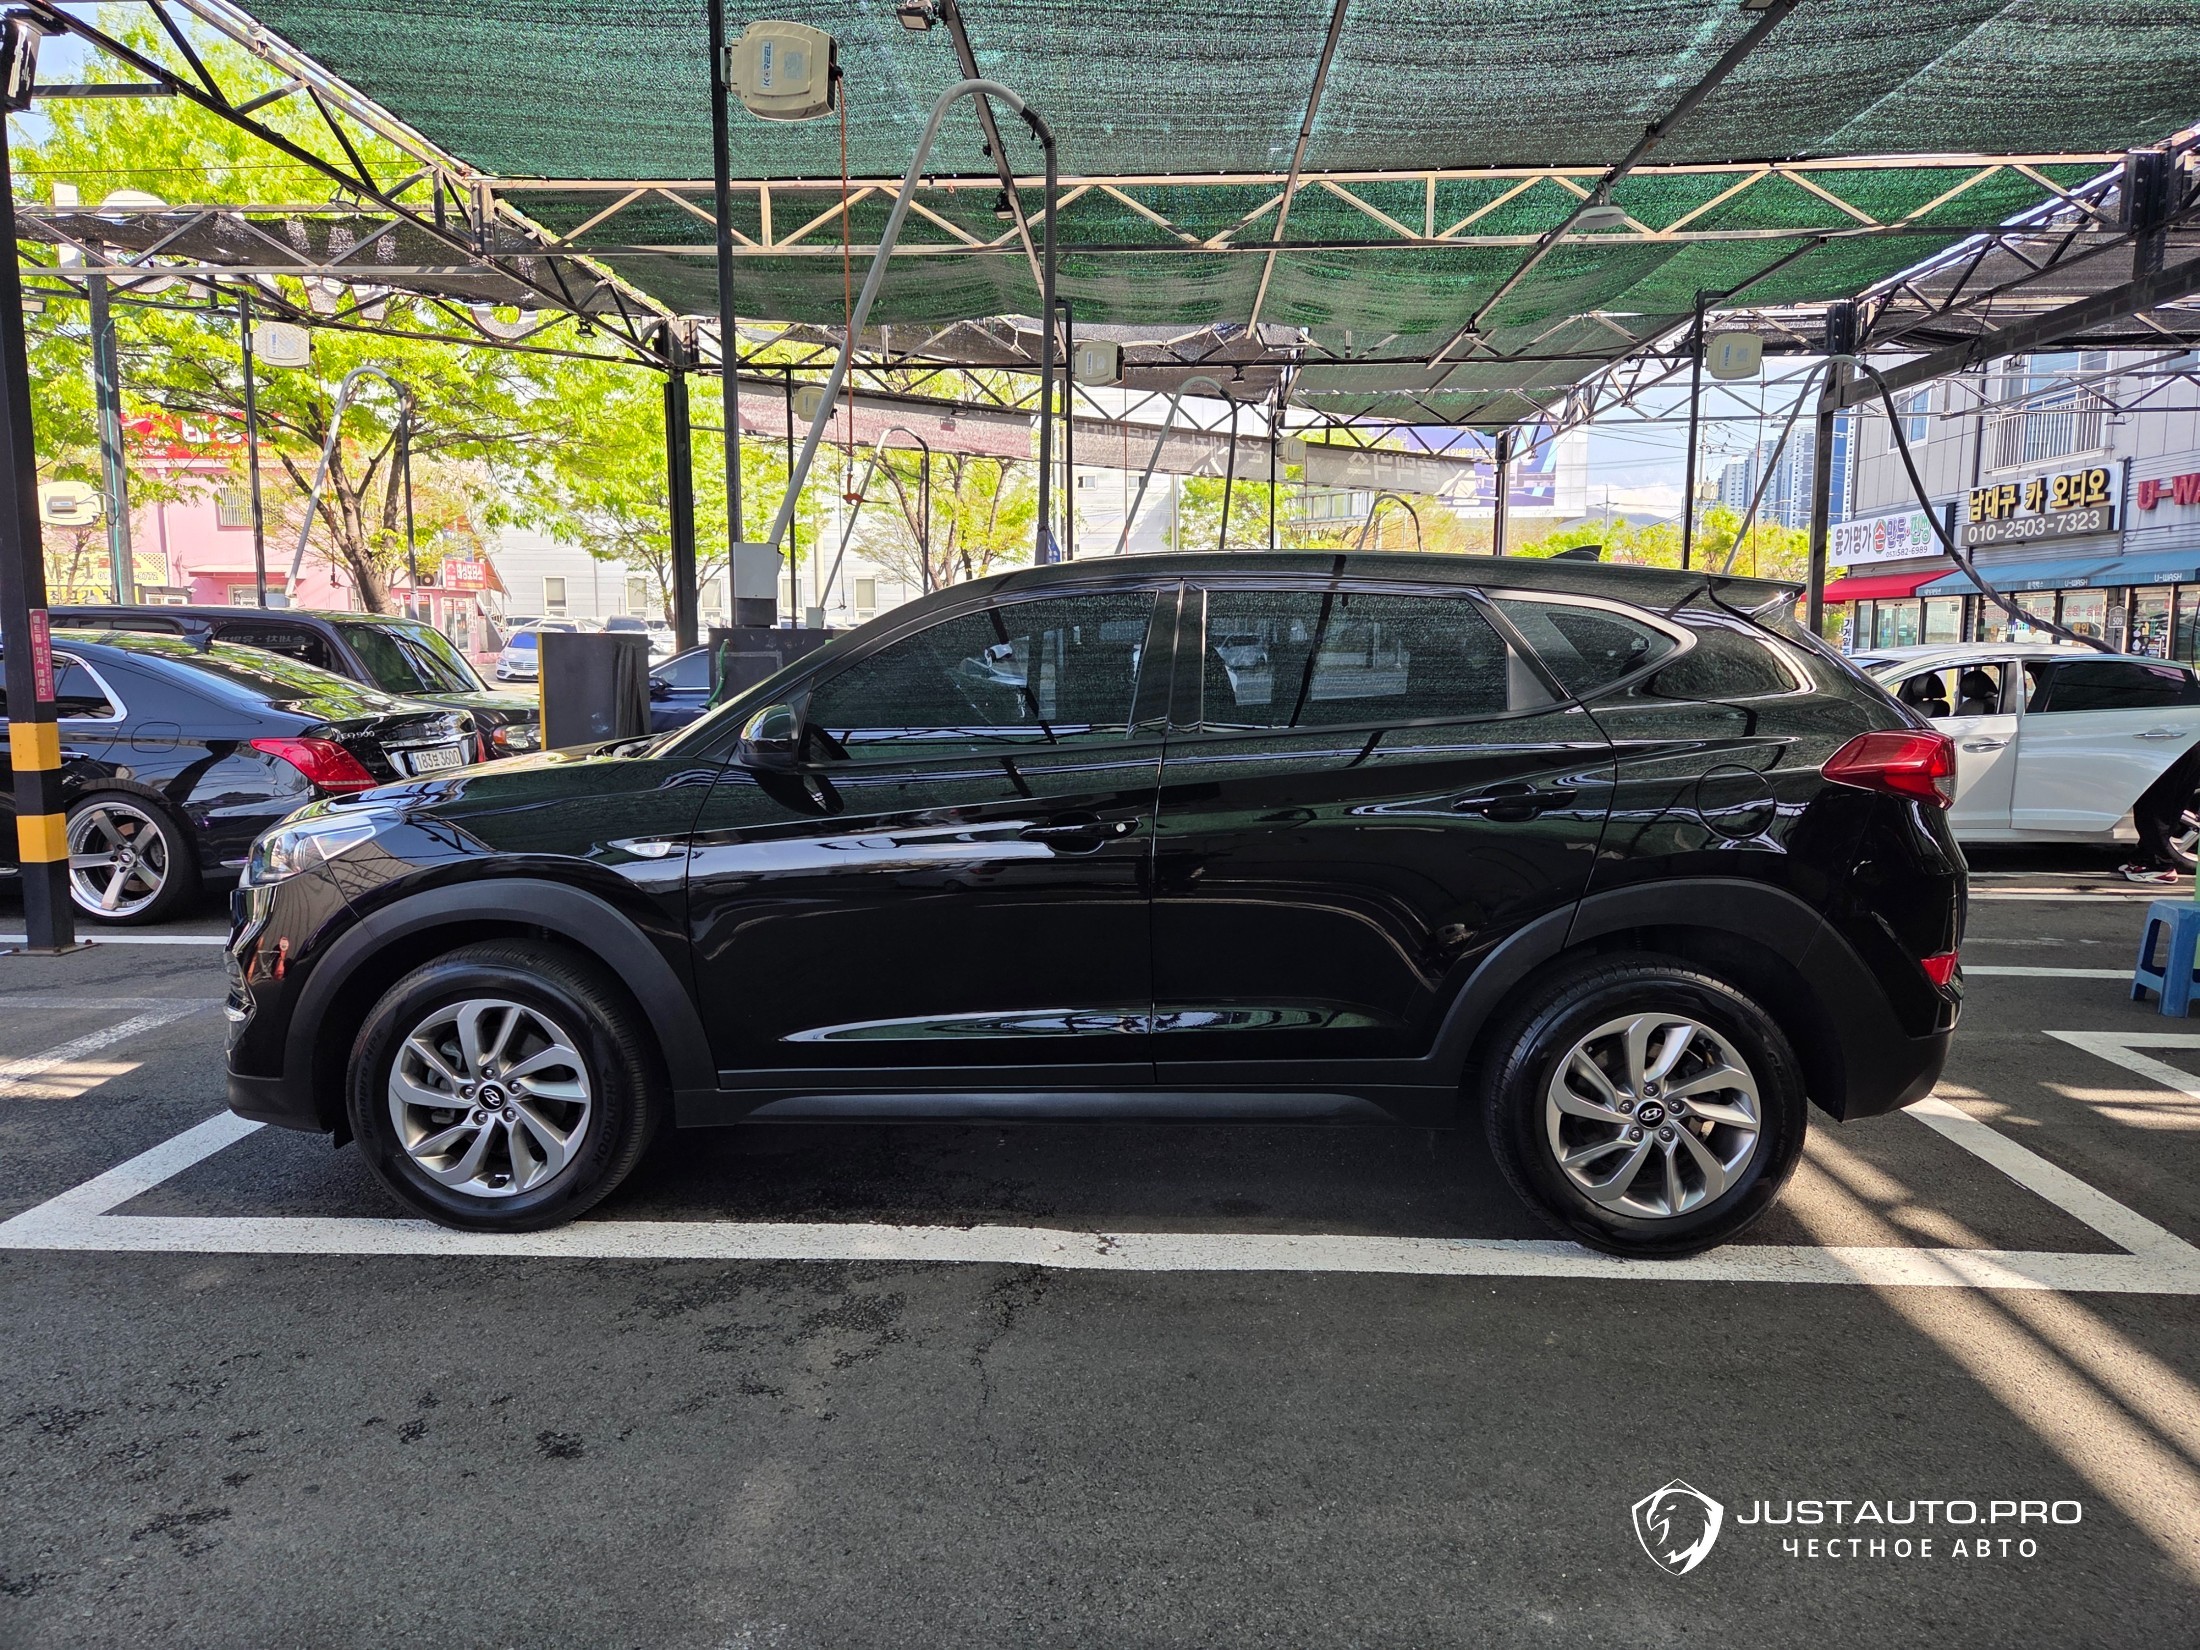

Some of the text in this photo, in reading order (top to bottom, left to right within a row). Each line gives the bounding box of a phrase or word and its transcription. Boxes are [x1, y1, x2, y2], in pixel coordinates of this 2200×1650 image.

[762, 42, 772, 87] KOREEL
[1969, 468, 2107, 522] 남대구 카 오디오
[2137, 473, 2200, 510] U-W
[1835, 523, 1871, 556] 윤가명가
[1968, 510, 2100, 543] 010-2503-7323
[2064, 578, 2088, 588] U-WASH
[2154, 572, 2182, 582] U-WASH
[2112, 616, 2123, 626] 509
